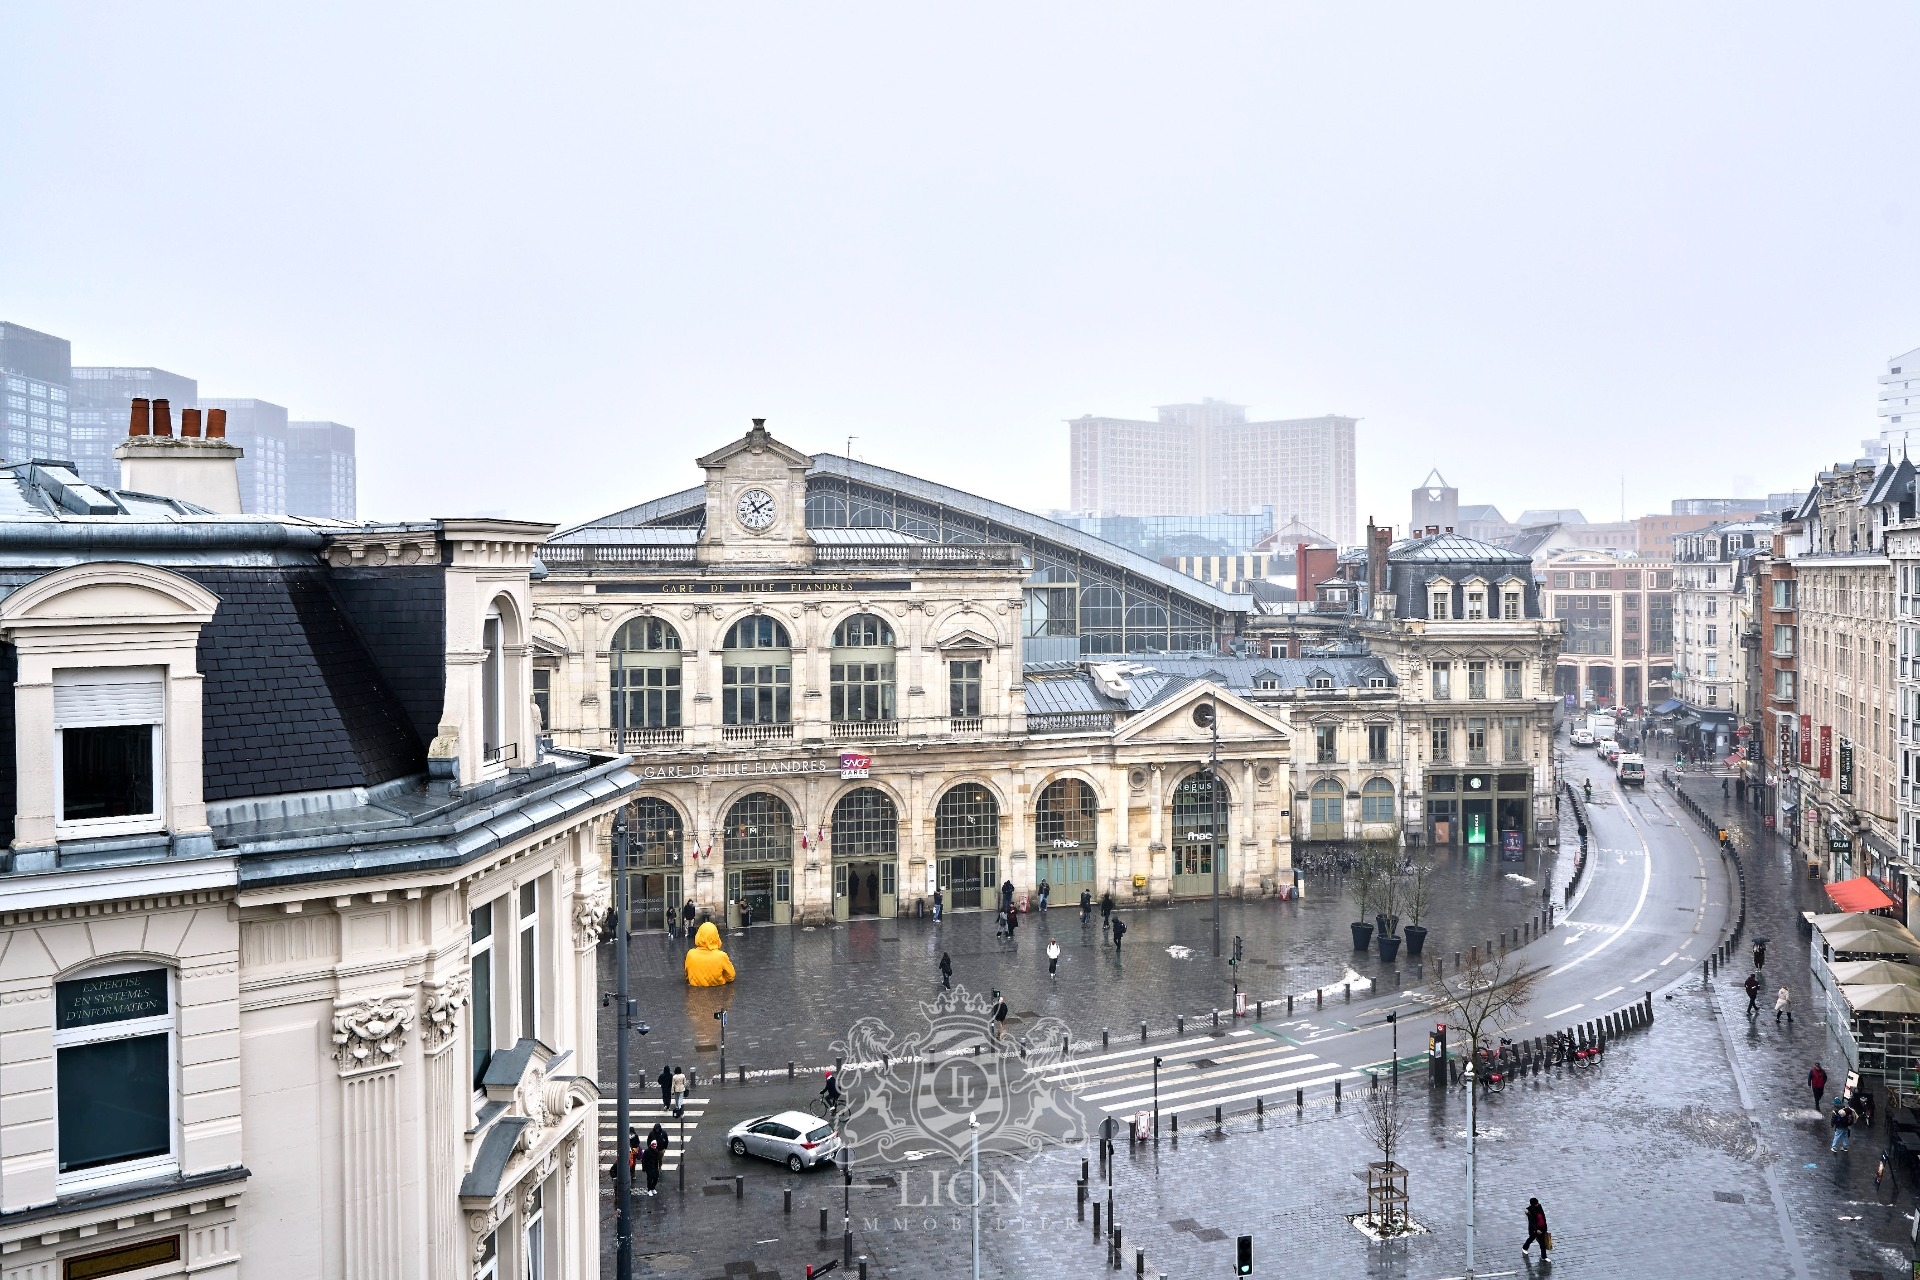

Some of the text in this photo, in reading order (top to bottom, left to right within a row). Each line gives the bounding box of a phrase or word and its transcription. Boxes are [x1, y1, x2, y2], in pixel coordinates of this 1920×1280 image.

[663, 582, 854, 593] GARE DE LILLE FLANDRES
[645, 760, 826, 778] GARE DE LILLE FLANDRES
[843, 758, 869, 768] SNCF
[1187, 831, 1213, 841] fnac
[1053, 839, 1080, 848] fnac
[83, 977, 141, 993] EXPERTISE
[74, 988, 151, 1007] EN SYSTEMES
[66, 999, 158, 1021] D'INFORMATION
